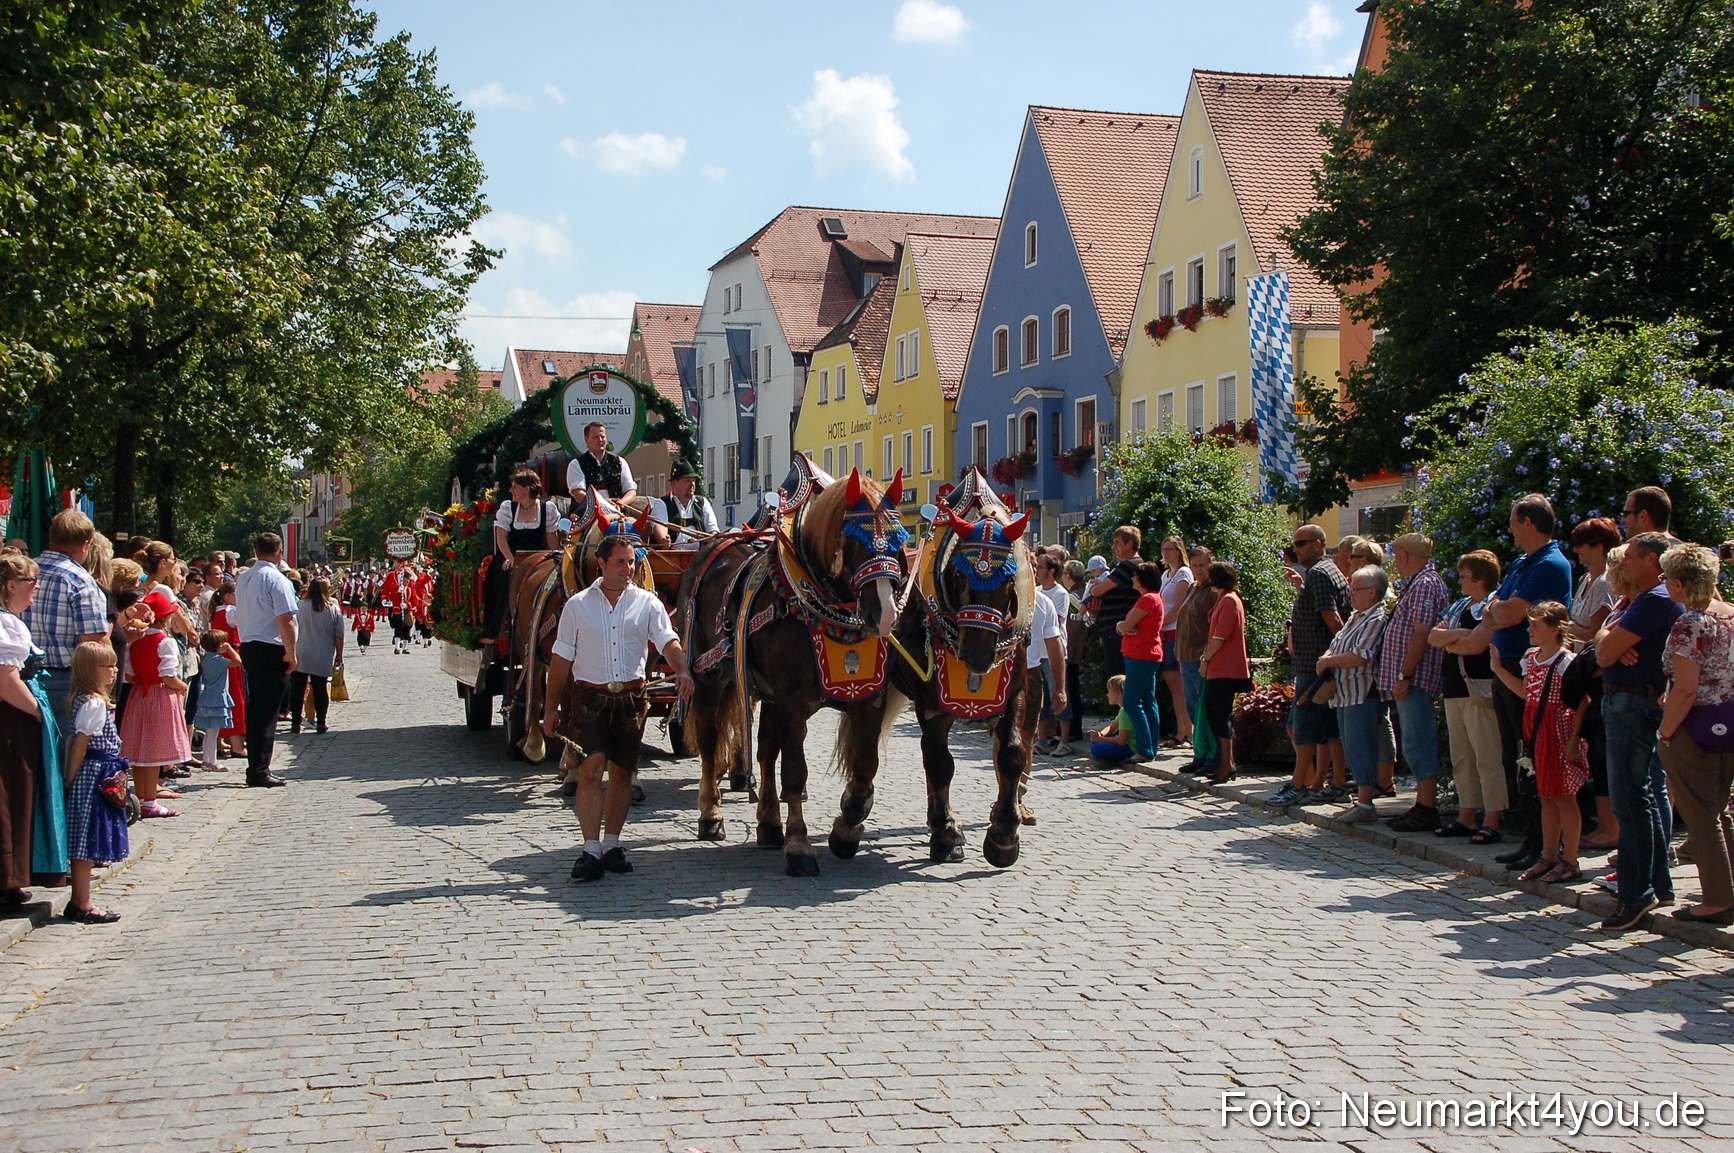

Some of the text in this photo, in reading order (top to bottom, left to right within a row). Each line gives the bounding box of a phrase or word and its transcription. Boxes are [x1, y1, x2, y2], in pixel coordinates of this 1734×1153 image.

[576, 397, 623, 405] Neumarkter
[568, 405, 631, 416] Lammsbräu
[827, 421, 847, 440] HOTEL
